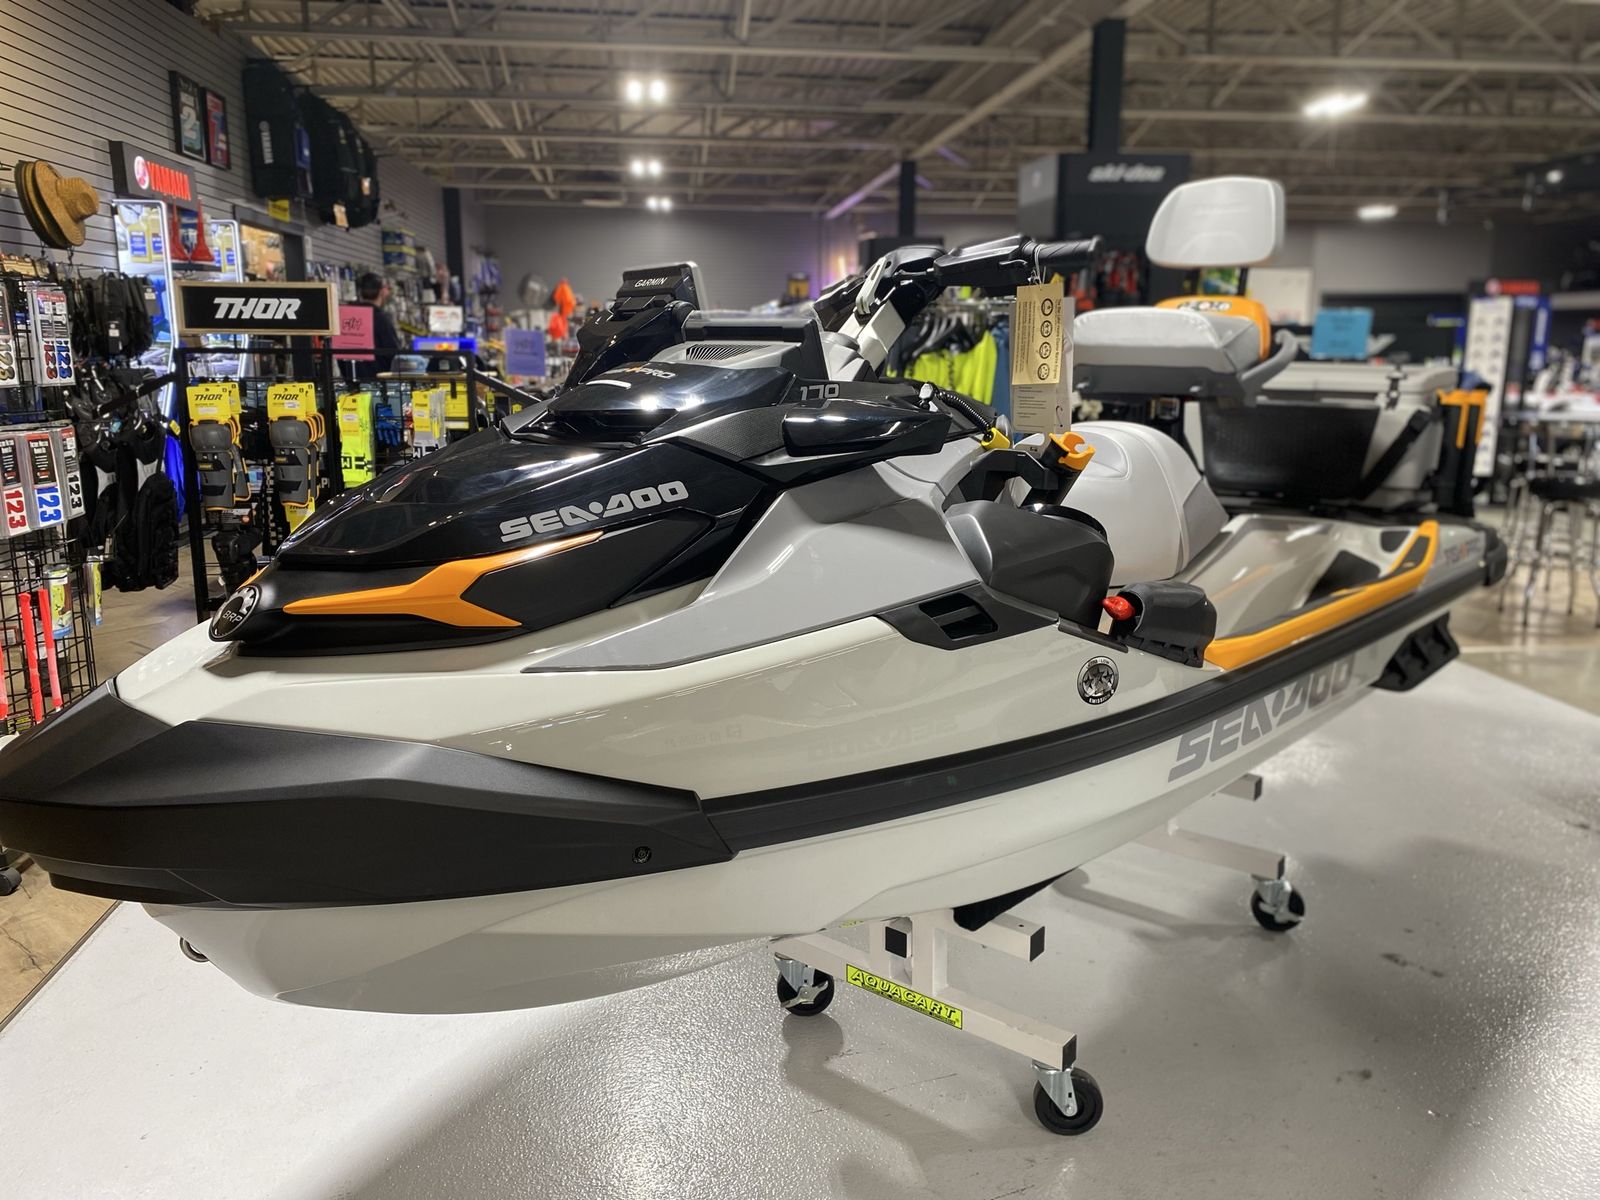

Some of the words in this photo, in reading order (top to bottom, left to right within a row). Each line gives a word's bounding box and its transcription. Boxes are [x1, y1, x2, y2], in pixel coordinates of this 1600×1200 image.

[147, 161, 191, 201] YAMAHA
[635, 277, 667, 287] GARMIN
[213, 297, 301, 320] THOR
[273, 393, 299, 401] THOR
[800, 383, 840, 401] 170
[36, 487, 62, 523] 123
[67, 475, 82, 509] 123
[4, 490, 27, 529] 123
[222, 610, 243, 623] BRP
[851, 968, 956, 1019] AQUACART
